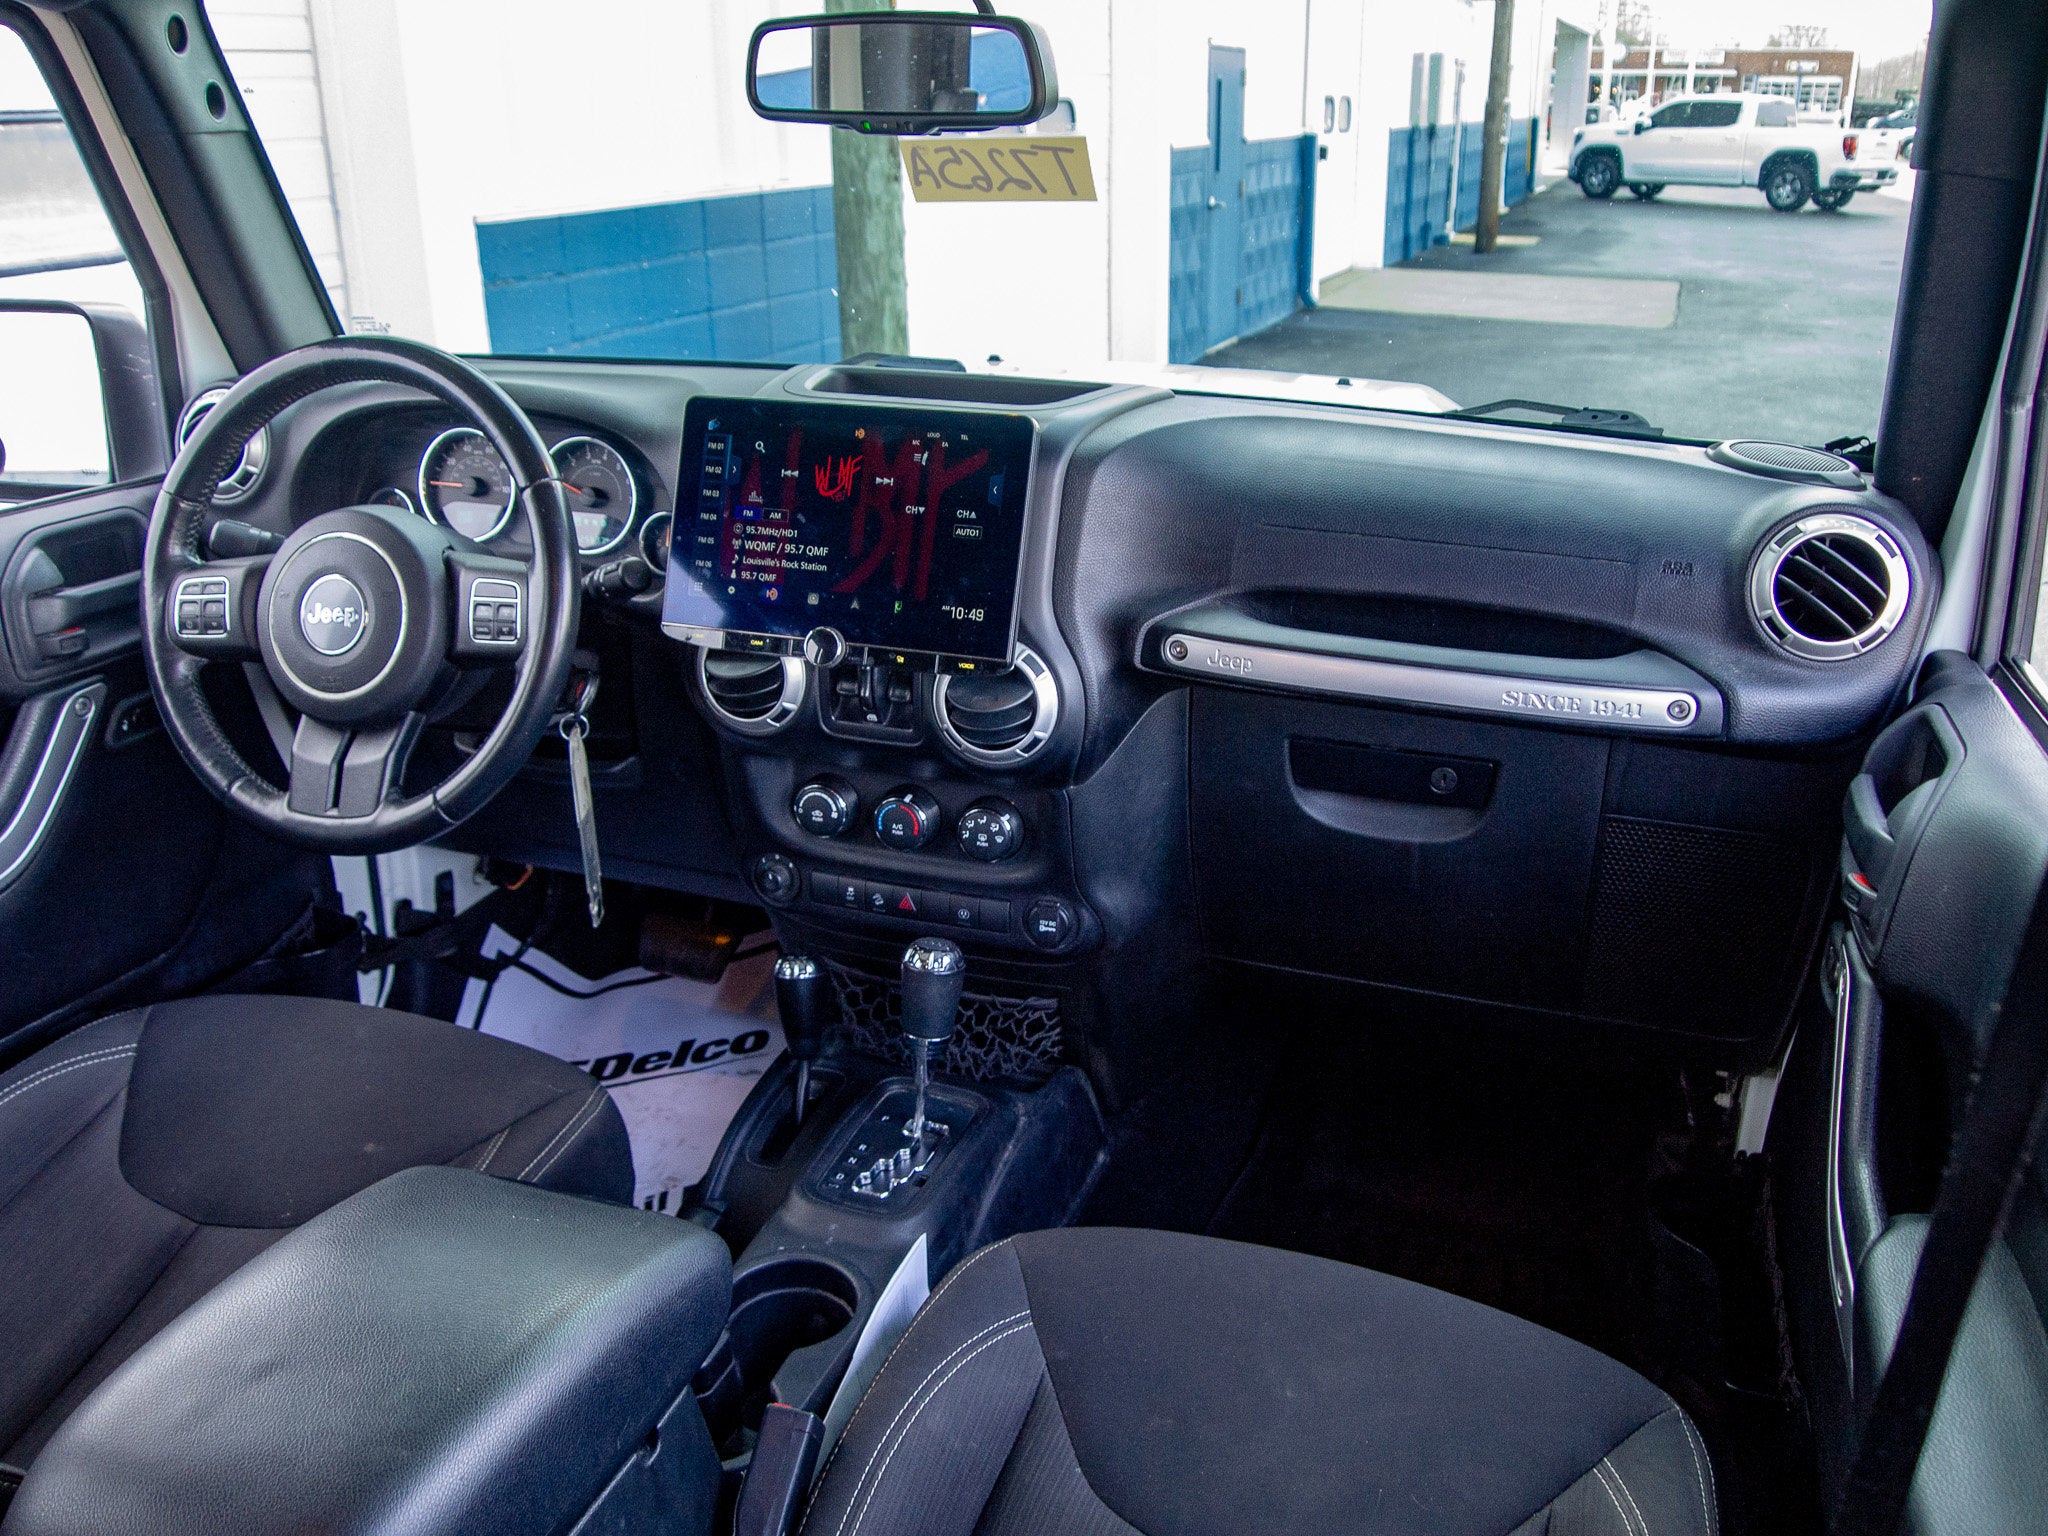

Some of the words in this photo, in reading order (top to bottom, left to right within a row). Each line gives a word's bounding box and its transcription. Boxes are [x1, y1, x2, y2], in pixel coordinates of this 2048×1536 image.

[707, 441, 716, 449] FM
[716, 442, 725, 450] 01
[705, 465, 714, 473] FM
[714, 466, 722, 474] 02
[702, 488, 712, 496] FM
[712, 489, 720, 497] 03
[700, 512, 709, 520] FM
[709, 513, 717, 521] 04
[743, 509, 754, 517] FM
[769, 511, 782, 520] AM
[745, 525, 798, 538] 95.7MHz/HD1
[955, 528, 979, 537] AUTO1
[744, 540, 776, 553] WQMF
[776, 542, 783, 554] /
[784, 543, 805, 554] 95.7
[806, 545, 829, 557] QMF
[742, 555, 780, 567] Louisville's
[781, 559, 799, 569] Rock
[800, 561, 827, 572] Station
[741, 571, 757, 580] 95.7
[758, 572, 777, 582] QMF
[306, 602, 357, 628] Jeep
[950, 606, 984, 621] 10:49
[1206, 648, 1253, 675] Jeep
[1502, 690, 1582, 713] SINCE
[1589, 698, 1643, 719] 1941
